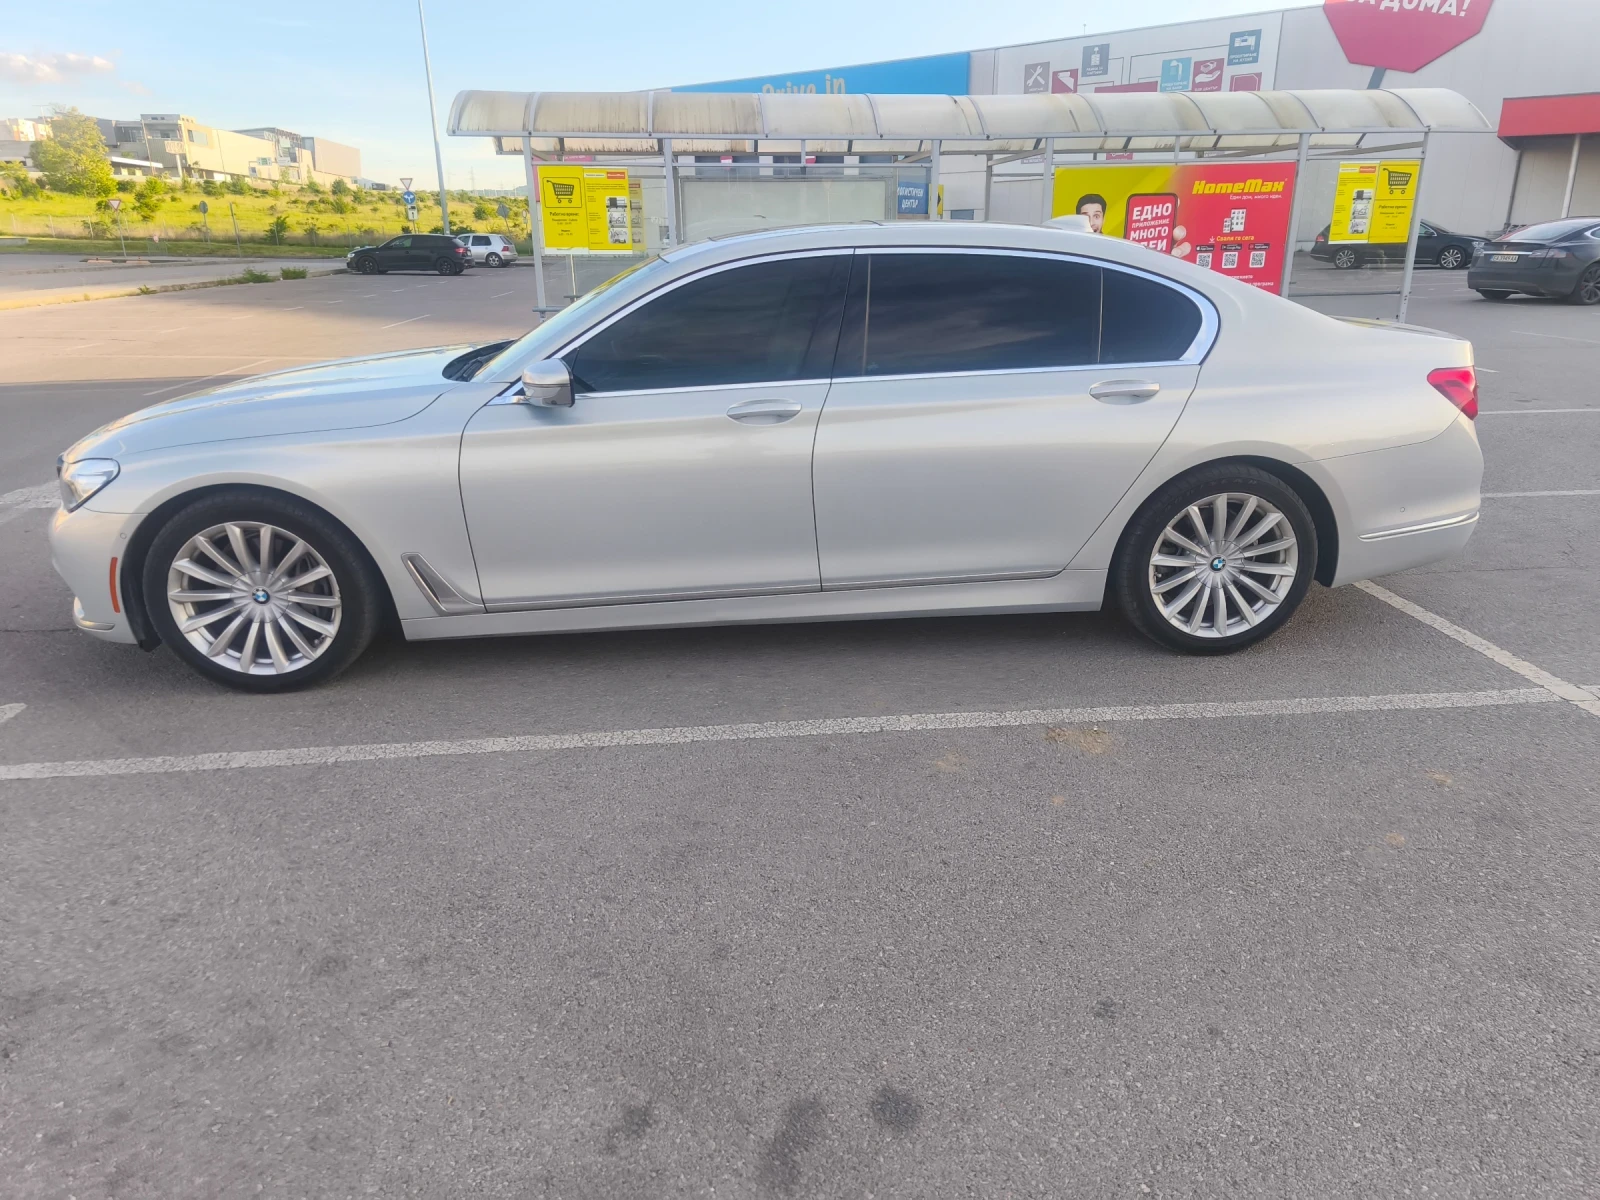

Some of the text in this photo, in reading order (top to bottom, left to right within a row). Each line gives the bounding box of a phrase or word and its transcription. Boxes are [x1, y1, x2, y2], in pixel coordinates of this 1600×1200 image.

[1192, 179, 1285, 194] HomeMax
[1132, 203, 1172, 221] ЕДНО
[1132, 218, 1170, 229] ПРИЛОЖЕНИЕ
[1130, 226, 1169, 241] МНОГО
